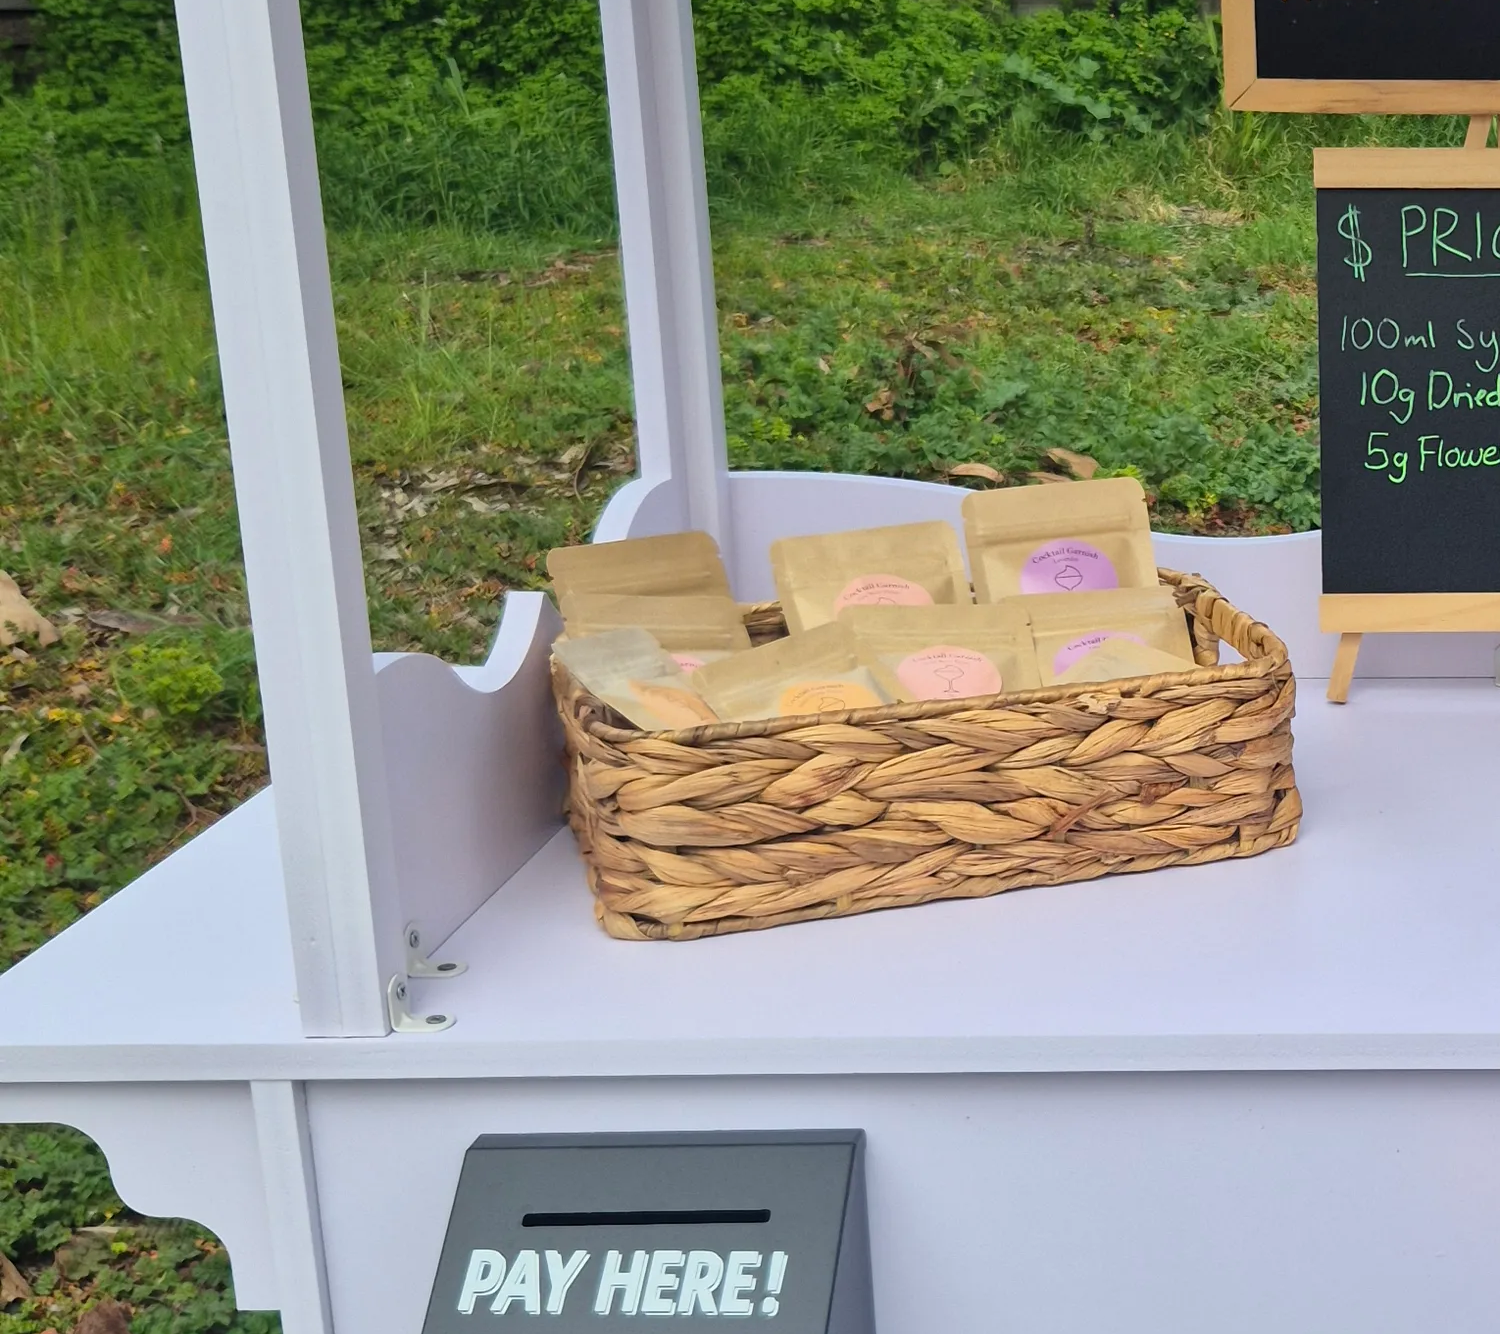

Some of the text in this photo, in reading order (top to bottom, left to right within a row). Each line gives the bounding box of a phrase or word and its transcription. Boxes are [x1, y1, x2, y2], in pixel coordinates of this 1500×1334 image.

[1340, 315, 1436, 351] 100ml
[1360, 368, 1415, 424] 10g
[1364, 431, 1409, 483] 5g
[456, 1247, 790, 1318] PAY HERE!
